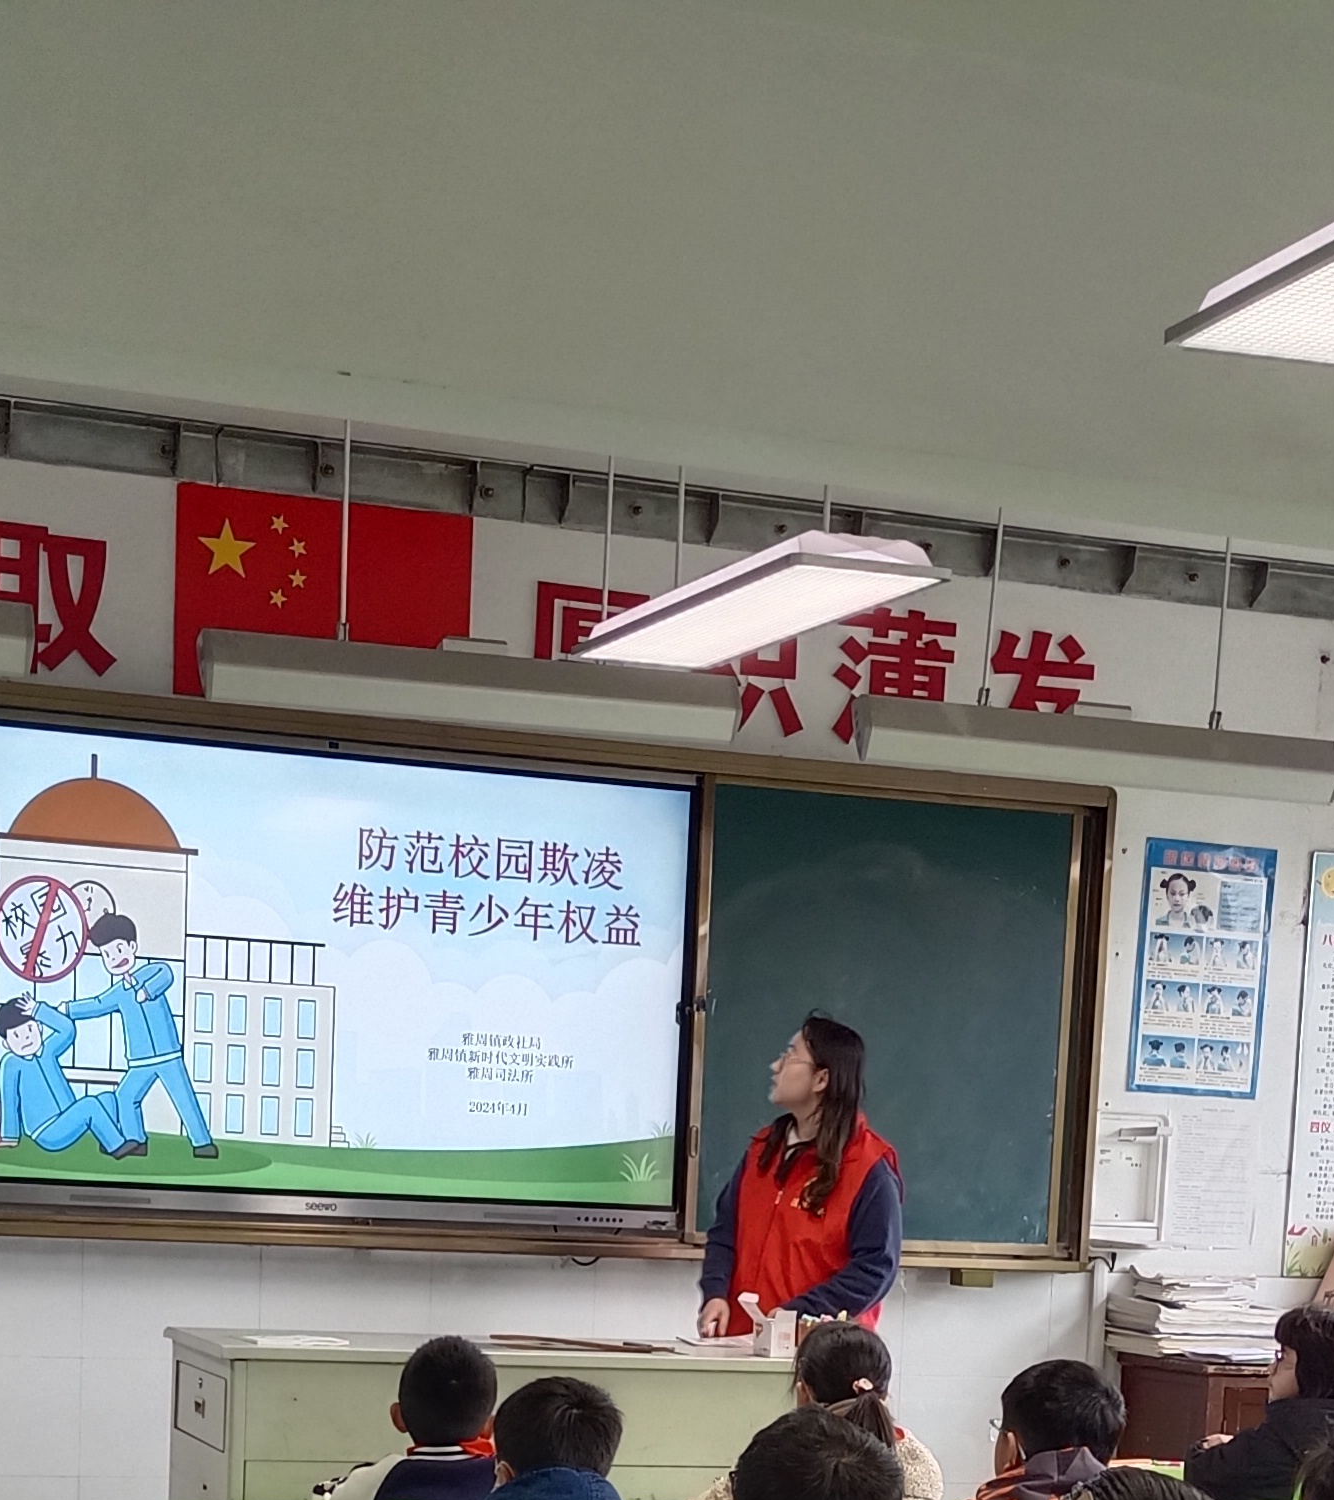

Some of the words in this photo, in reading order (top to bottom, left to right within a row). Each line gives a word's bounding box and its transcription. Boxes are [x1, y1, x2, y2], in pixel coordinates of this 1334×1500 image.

[358, 826, 624, 890] 防范校园欺凌
[332, 882, 641, 947] 维护青少年权益
[427, 1047, 574, 1069] 雅周镇新时代文明实践所
[467, 1067, 534, 1084] 雅周司法所
[305, 1202, 337, 1212] seewo
